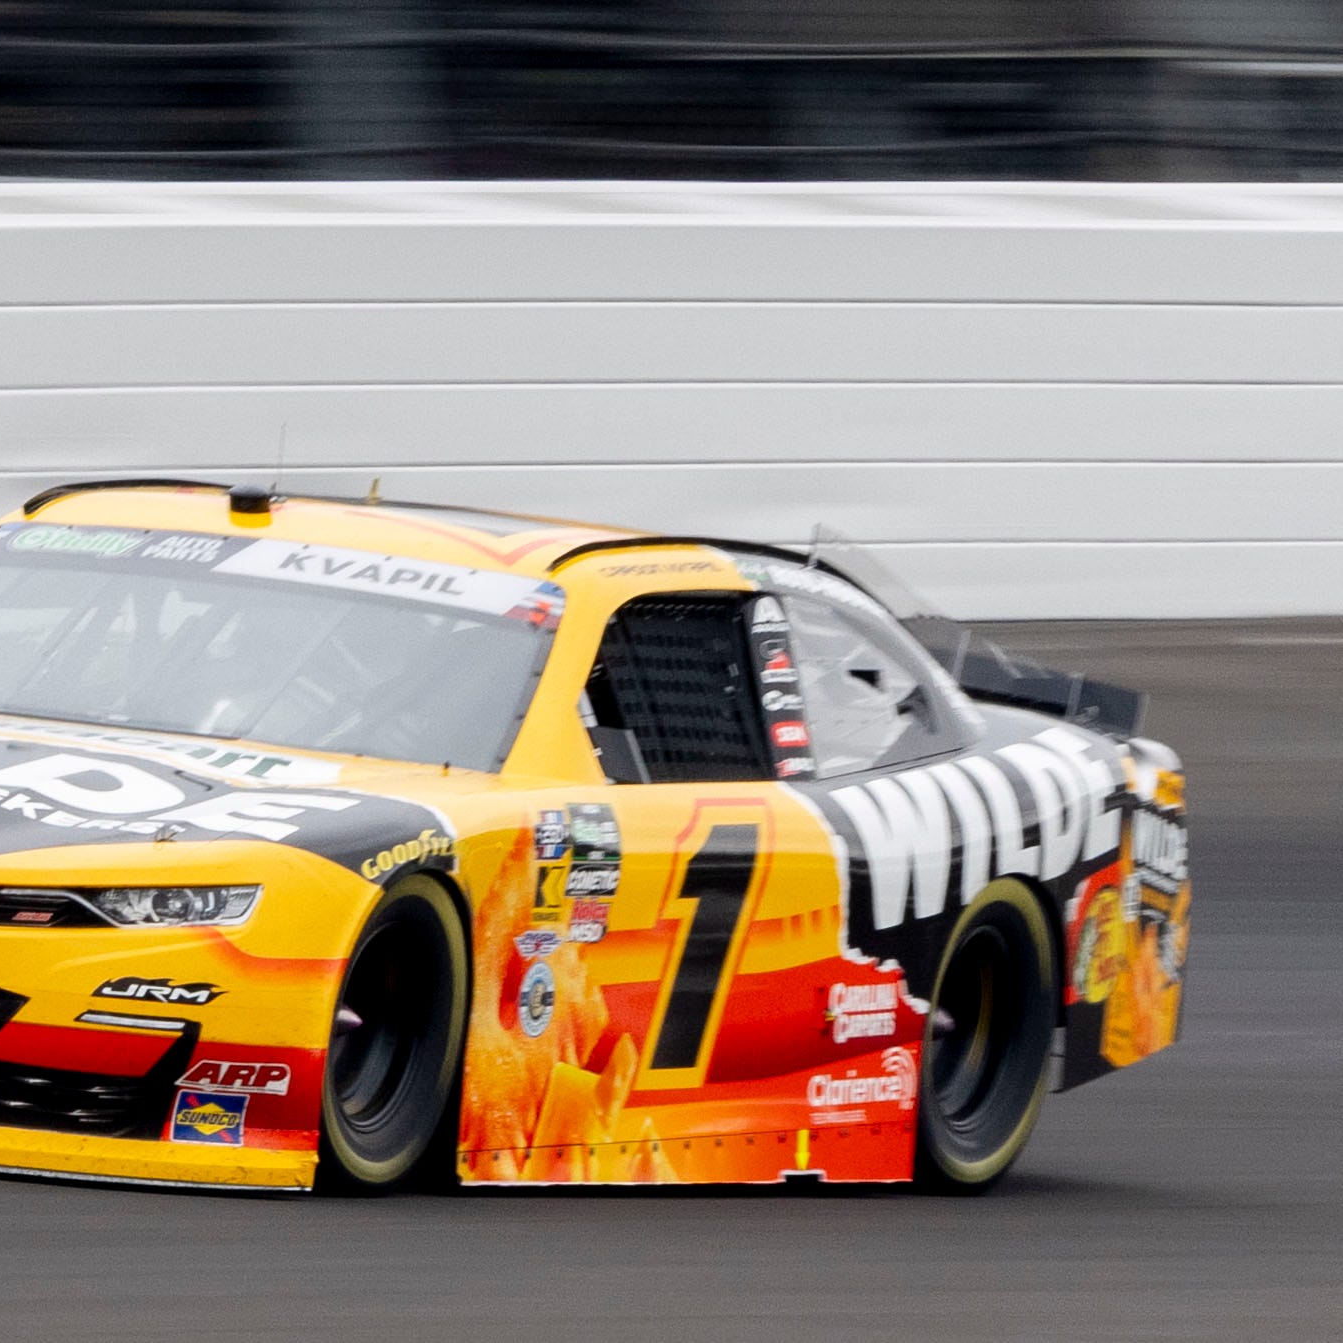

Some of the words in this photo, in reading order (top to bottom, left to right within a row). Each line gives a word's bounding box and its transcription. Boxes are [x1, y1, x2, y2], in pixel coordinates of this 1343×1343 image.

[278, 551, 465, 597] KVAPIL
[827, 728, 1124, 930] WILDE
[646, 819, 763, 1076] 1
[101, 983, 211, 1004] JRM
[184, 1063, 289, 1088] ARP
[179, 1110, 239, 1127] SUNOCO
